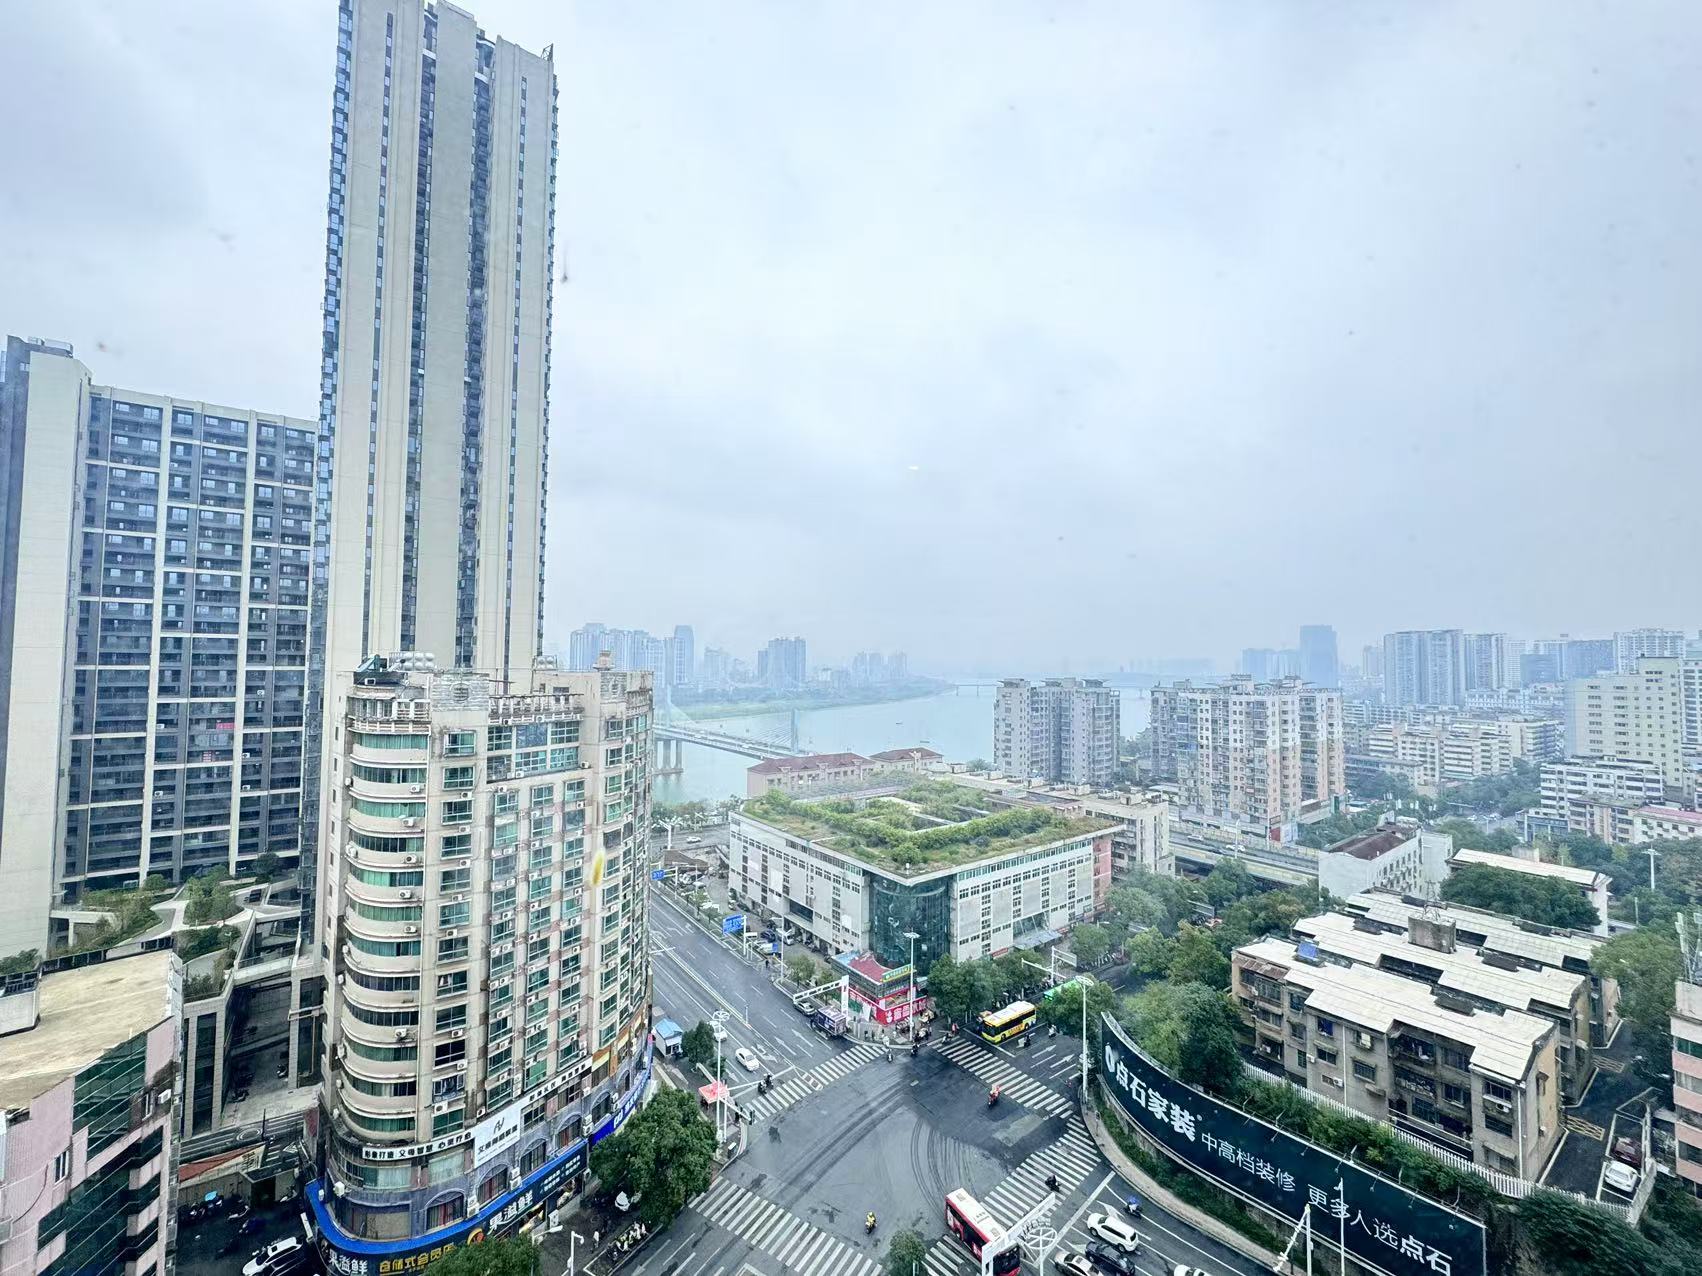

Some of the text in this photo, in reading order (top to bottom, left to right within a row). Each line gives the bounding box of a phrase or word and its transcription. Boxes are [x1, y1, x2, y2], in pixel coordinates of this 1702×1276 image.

[1116, 1060, 1195, 1142] 点石家装
[1201, 1132, 1453, 1276] 中高档装修 更多人选点石
